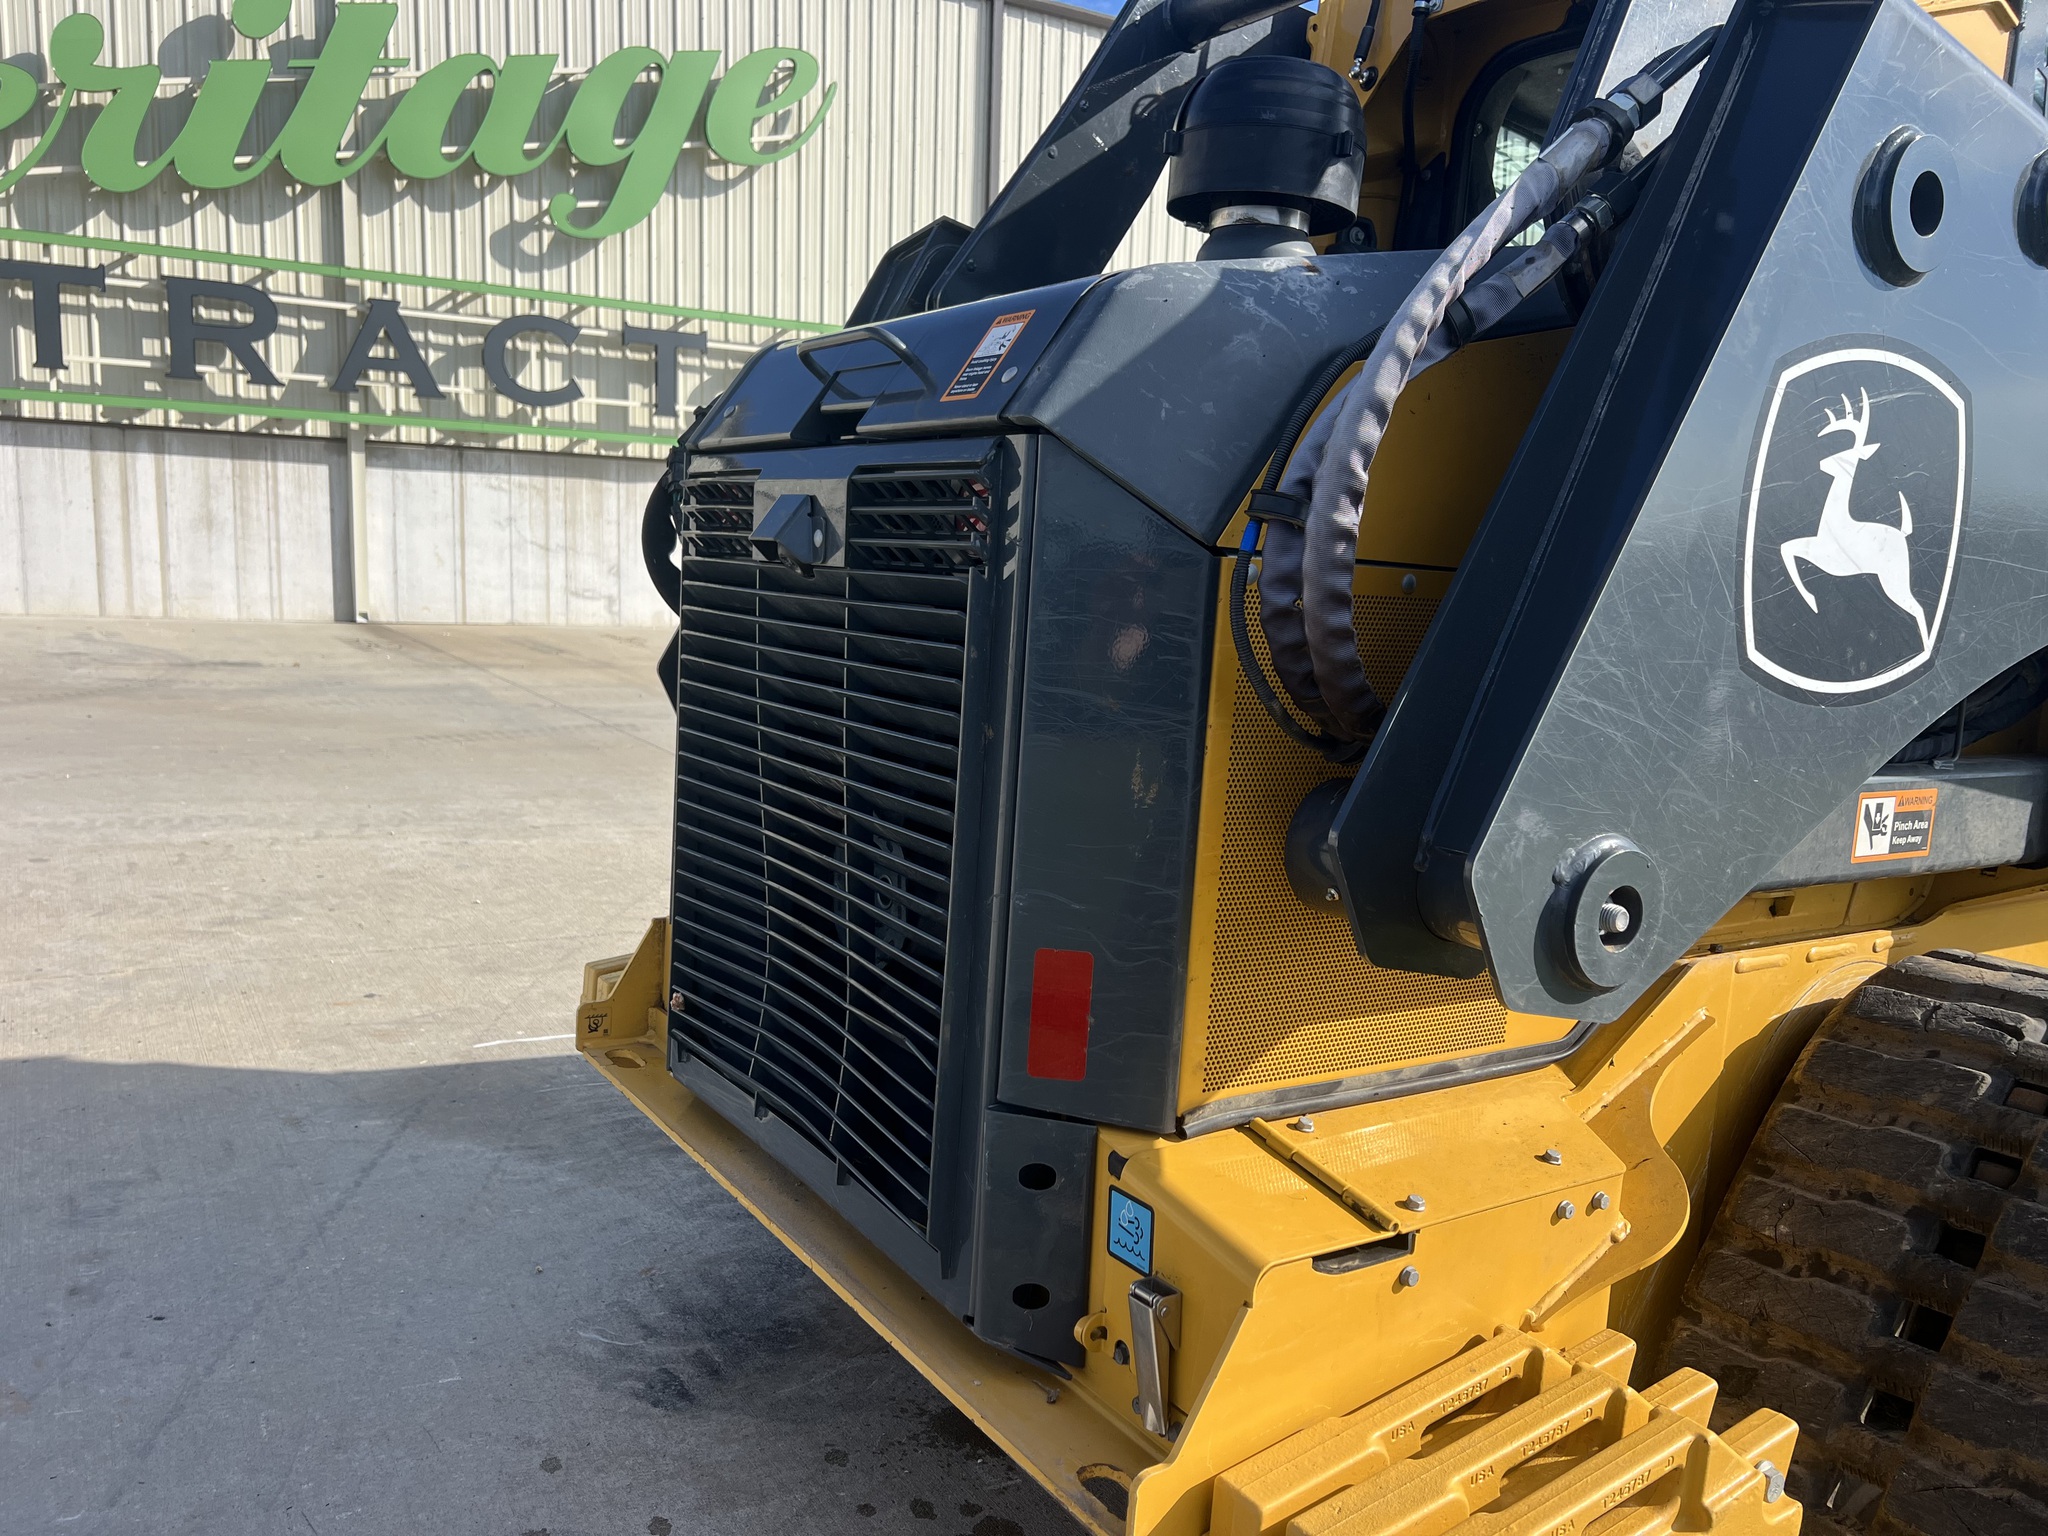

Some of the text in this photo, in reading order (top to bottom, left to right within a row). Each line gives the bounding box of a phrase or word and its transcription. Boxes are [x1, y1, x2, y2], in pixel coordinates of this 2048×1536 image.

[1904, 795, 1933, 806] WARNING
[1894, 819, 1928, 831] Pinch Area
[1892, 834, 1923, 846] Keep Away
[1391, 1420, 1415, 1442] USA
[1470, 1465, 1494, 1487] USA
[1551, 1519, 1575, 1536] USA
